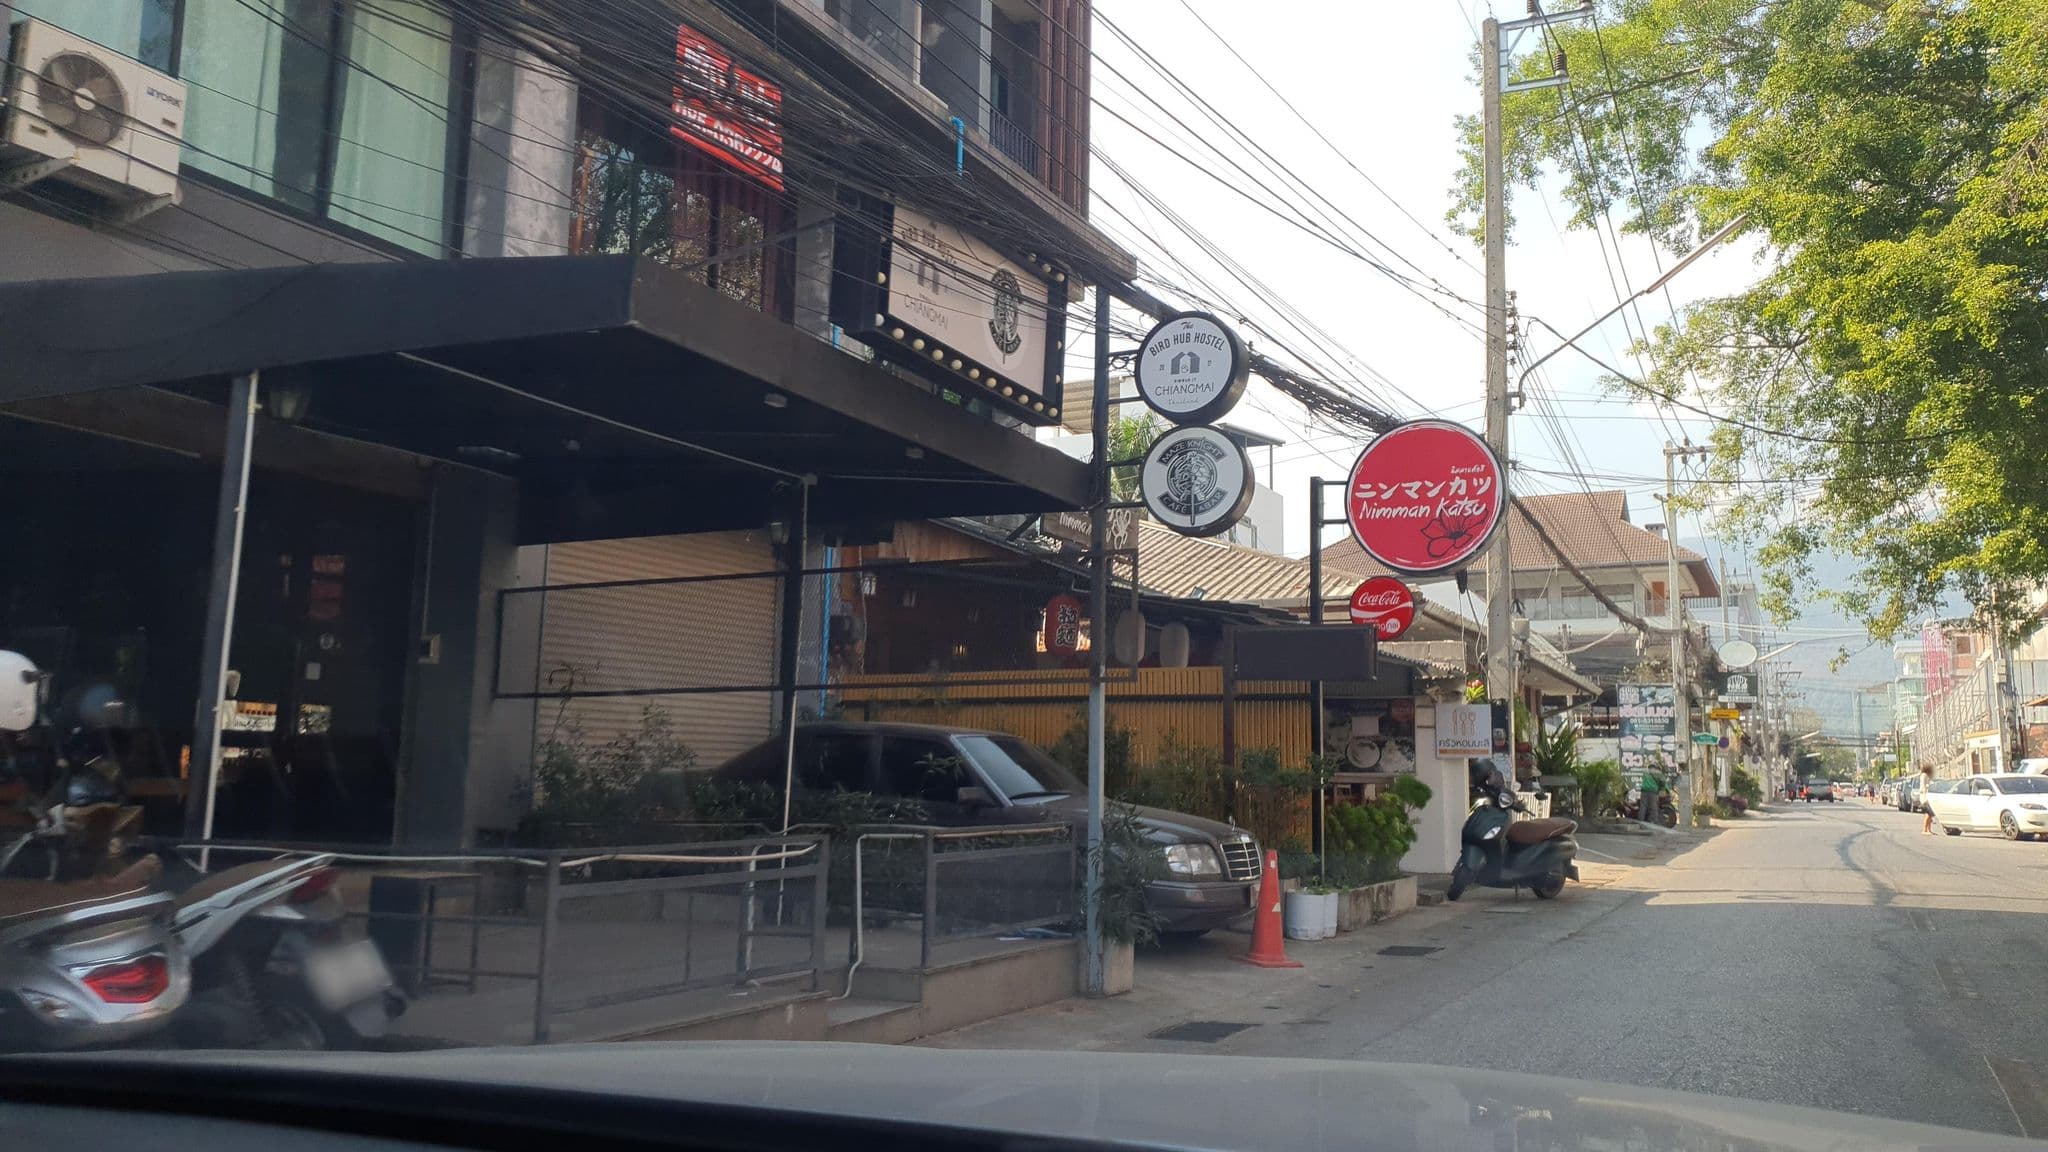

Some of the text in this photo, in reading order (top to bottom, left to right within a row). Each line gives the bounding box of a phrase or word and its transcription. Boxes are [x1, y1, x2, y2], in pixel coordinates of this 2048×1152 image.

[1181, 321, 1194, 330] The
[1149, 332, 1225, 357] BIRD HUB HOSTEL
[1154, 382, 1214, 396] CHIANGMAI
[1162, 439, 1223, 464] MAZE KNIGHT
[1355, 476, 1492, 500] ニンマンカツ
[1359, 496, 1486, 520] Nimman Katsu
